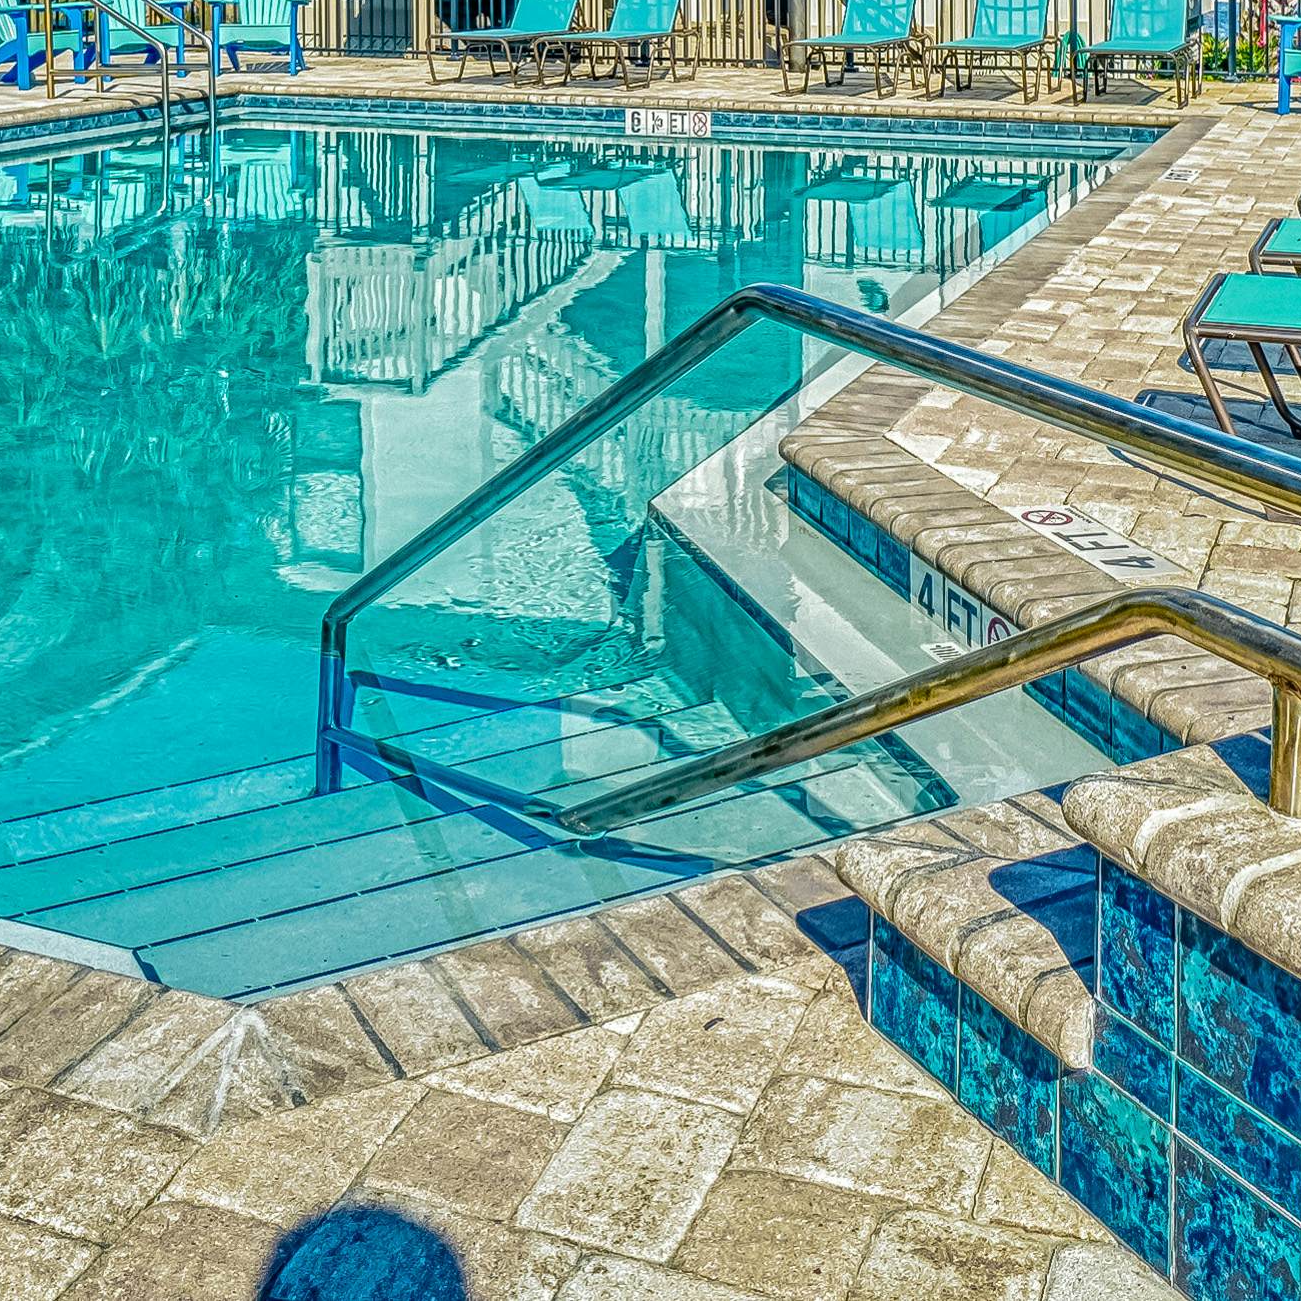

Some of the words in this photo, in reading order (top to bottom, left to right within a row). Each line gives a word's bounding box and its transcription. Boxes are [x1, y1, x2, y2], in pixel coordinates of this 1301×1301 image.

[1051, 532, 1130, 551] FT
[1099, 555, 1156, 569] 4
[917, 571, 936, 618] 4
[947, 587, 978, 648] FT
